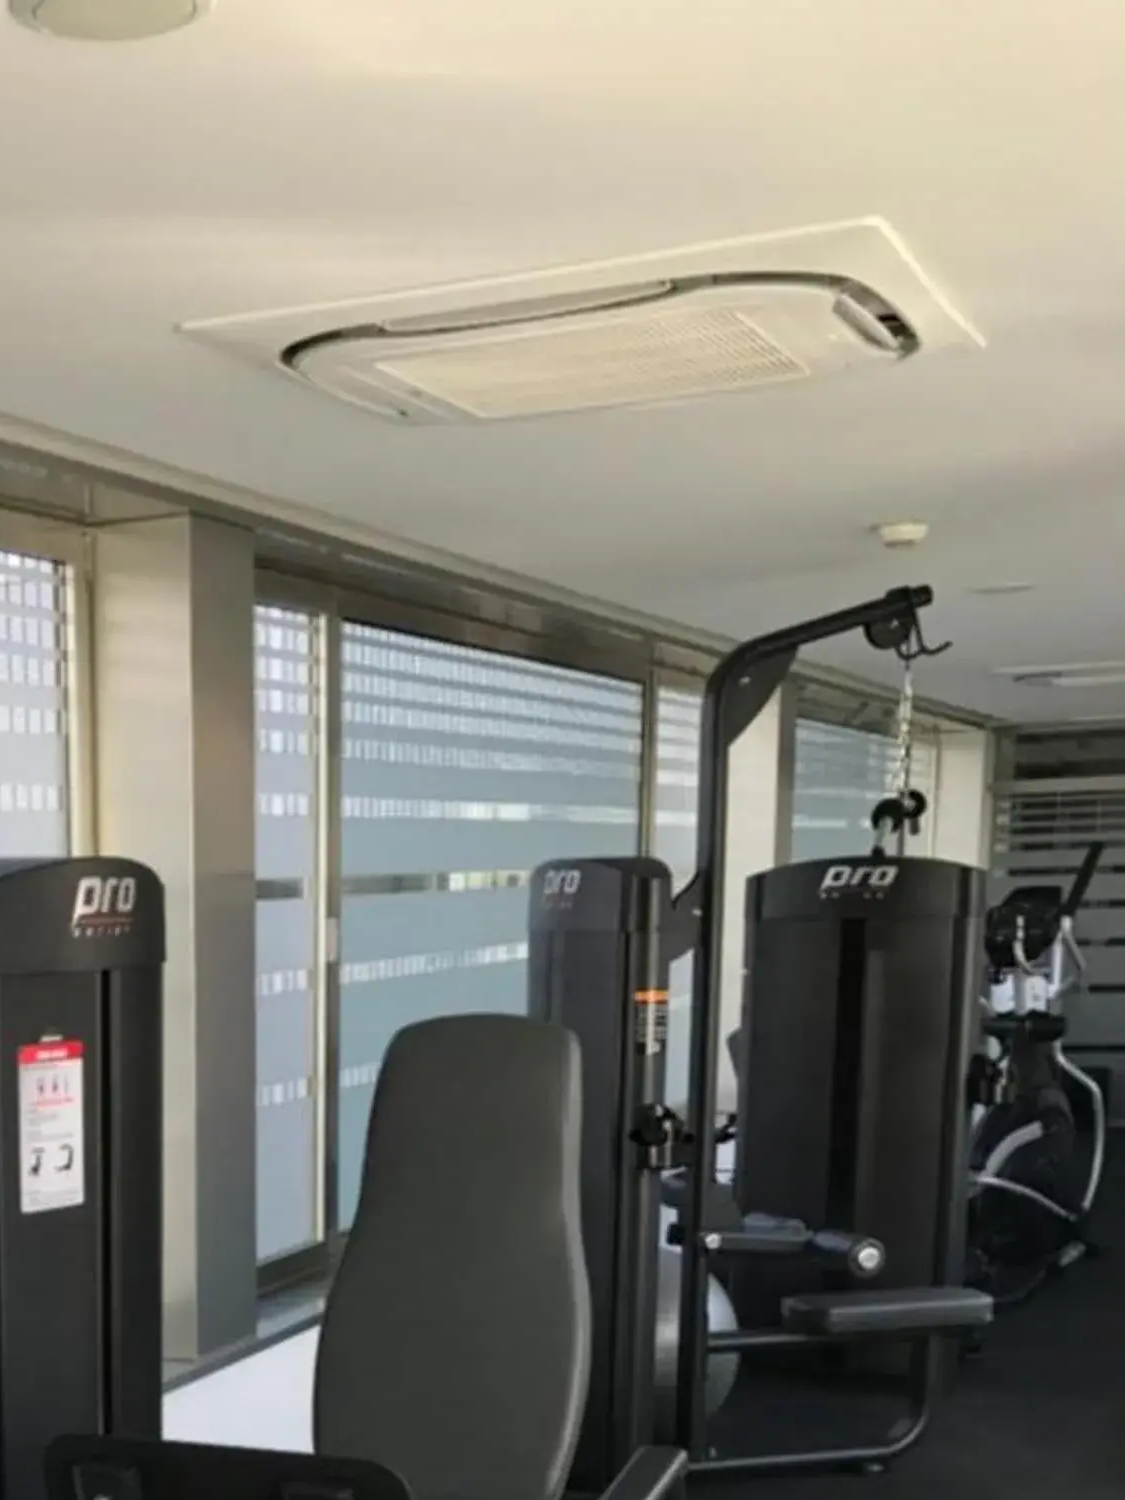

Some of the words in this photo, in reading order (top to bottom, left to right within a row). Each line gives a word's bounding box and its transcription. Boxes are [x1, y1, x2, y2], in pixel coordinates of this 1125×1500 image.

[543, 868, 581, 897] pro
[819, 865, 899, 891] pro
[72, 876, 136, 923] pro
